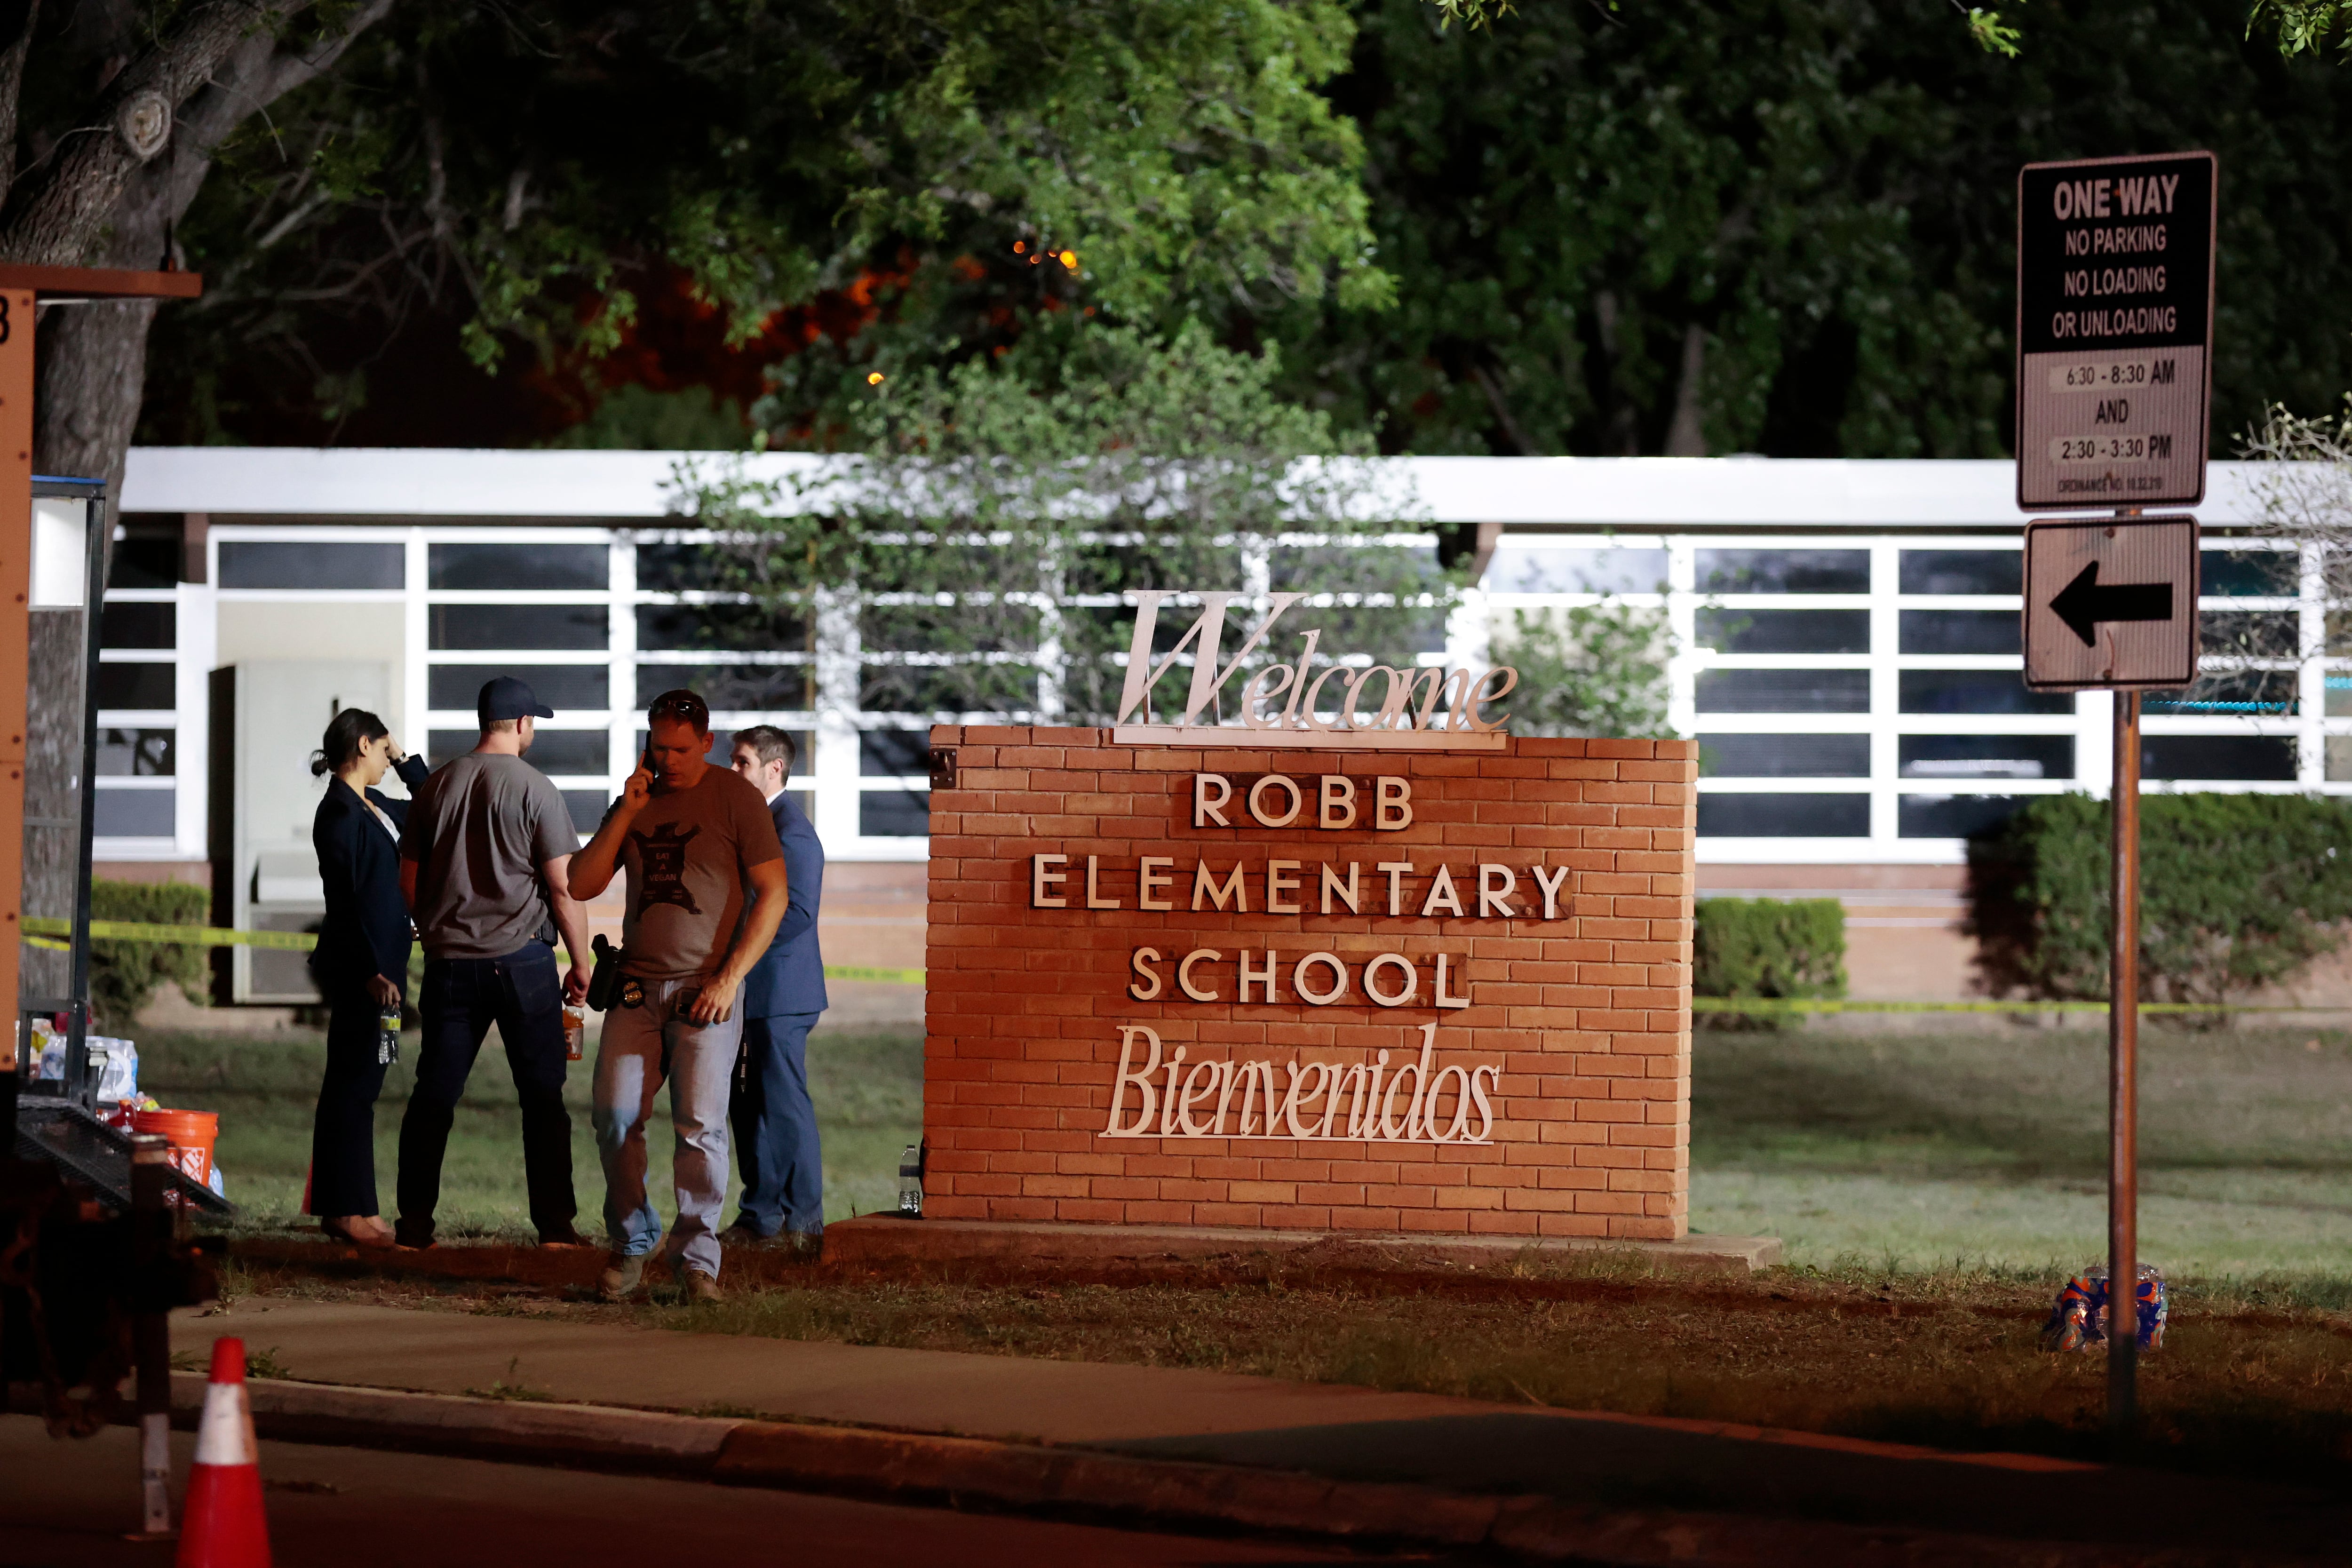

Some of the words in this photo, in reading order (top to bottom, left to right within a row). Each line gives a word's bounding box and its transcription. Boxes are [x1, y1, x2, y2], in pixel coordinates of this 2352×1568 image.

[2054, 178, 2111, 220] ONE
[2119, 174, 2179, 216] WAY
[2066, 229, 2090, 256] NO
[2094, 224, 2166, 255] PARKING
[2065, 269, 2089, 297] NO
[2093, 265, 2166, 295] LOADING
[2052, 311, 2076, 338] OR
[2081, 306, 2176, 337] UNLOADING
[2111, 364, 2145, 383] 8:30
[2150, 359, 2175, 385] AM
[2095, 399, 2129, 424] AND
[2062, 440, 2095, 459] 2:30
[2110, 439, 2143, 458] 3:30
[2148, 434, 2172, 460] PM
[1117, 589, 1518, 732] Welcome
[1196, 773, 1413, 830] ROBB
[1033, 853, 1570, 919] ELEMENTARY
[1129, 947, 1470, 1008] SCHOOL
[1098, 1022, 1501, 1142] Bienvenidos
